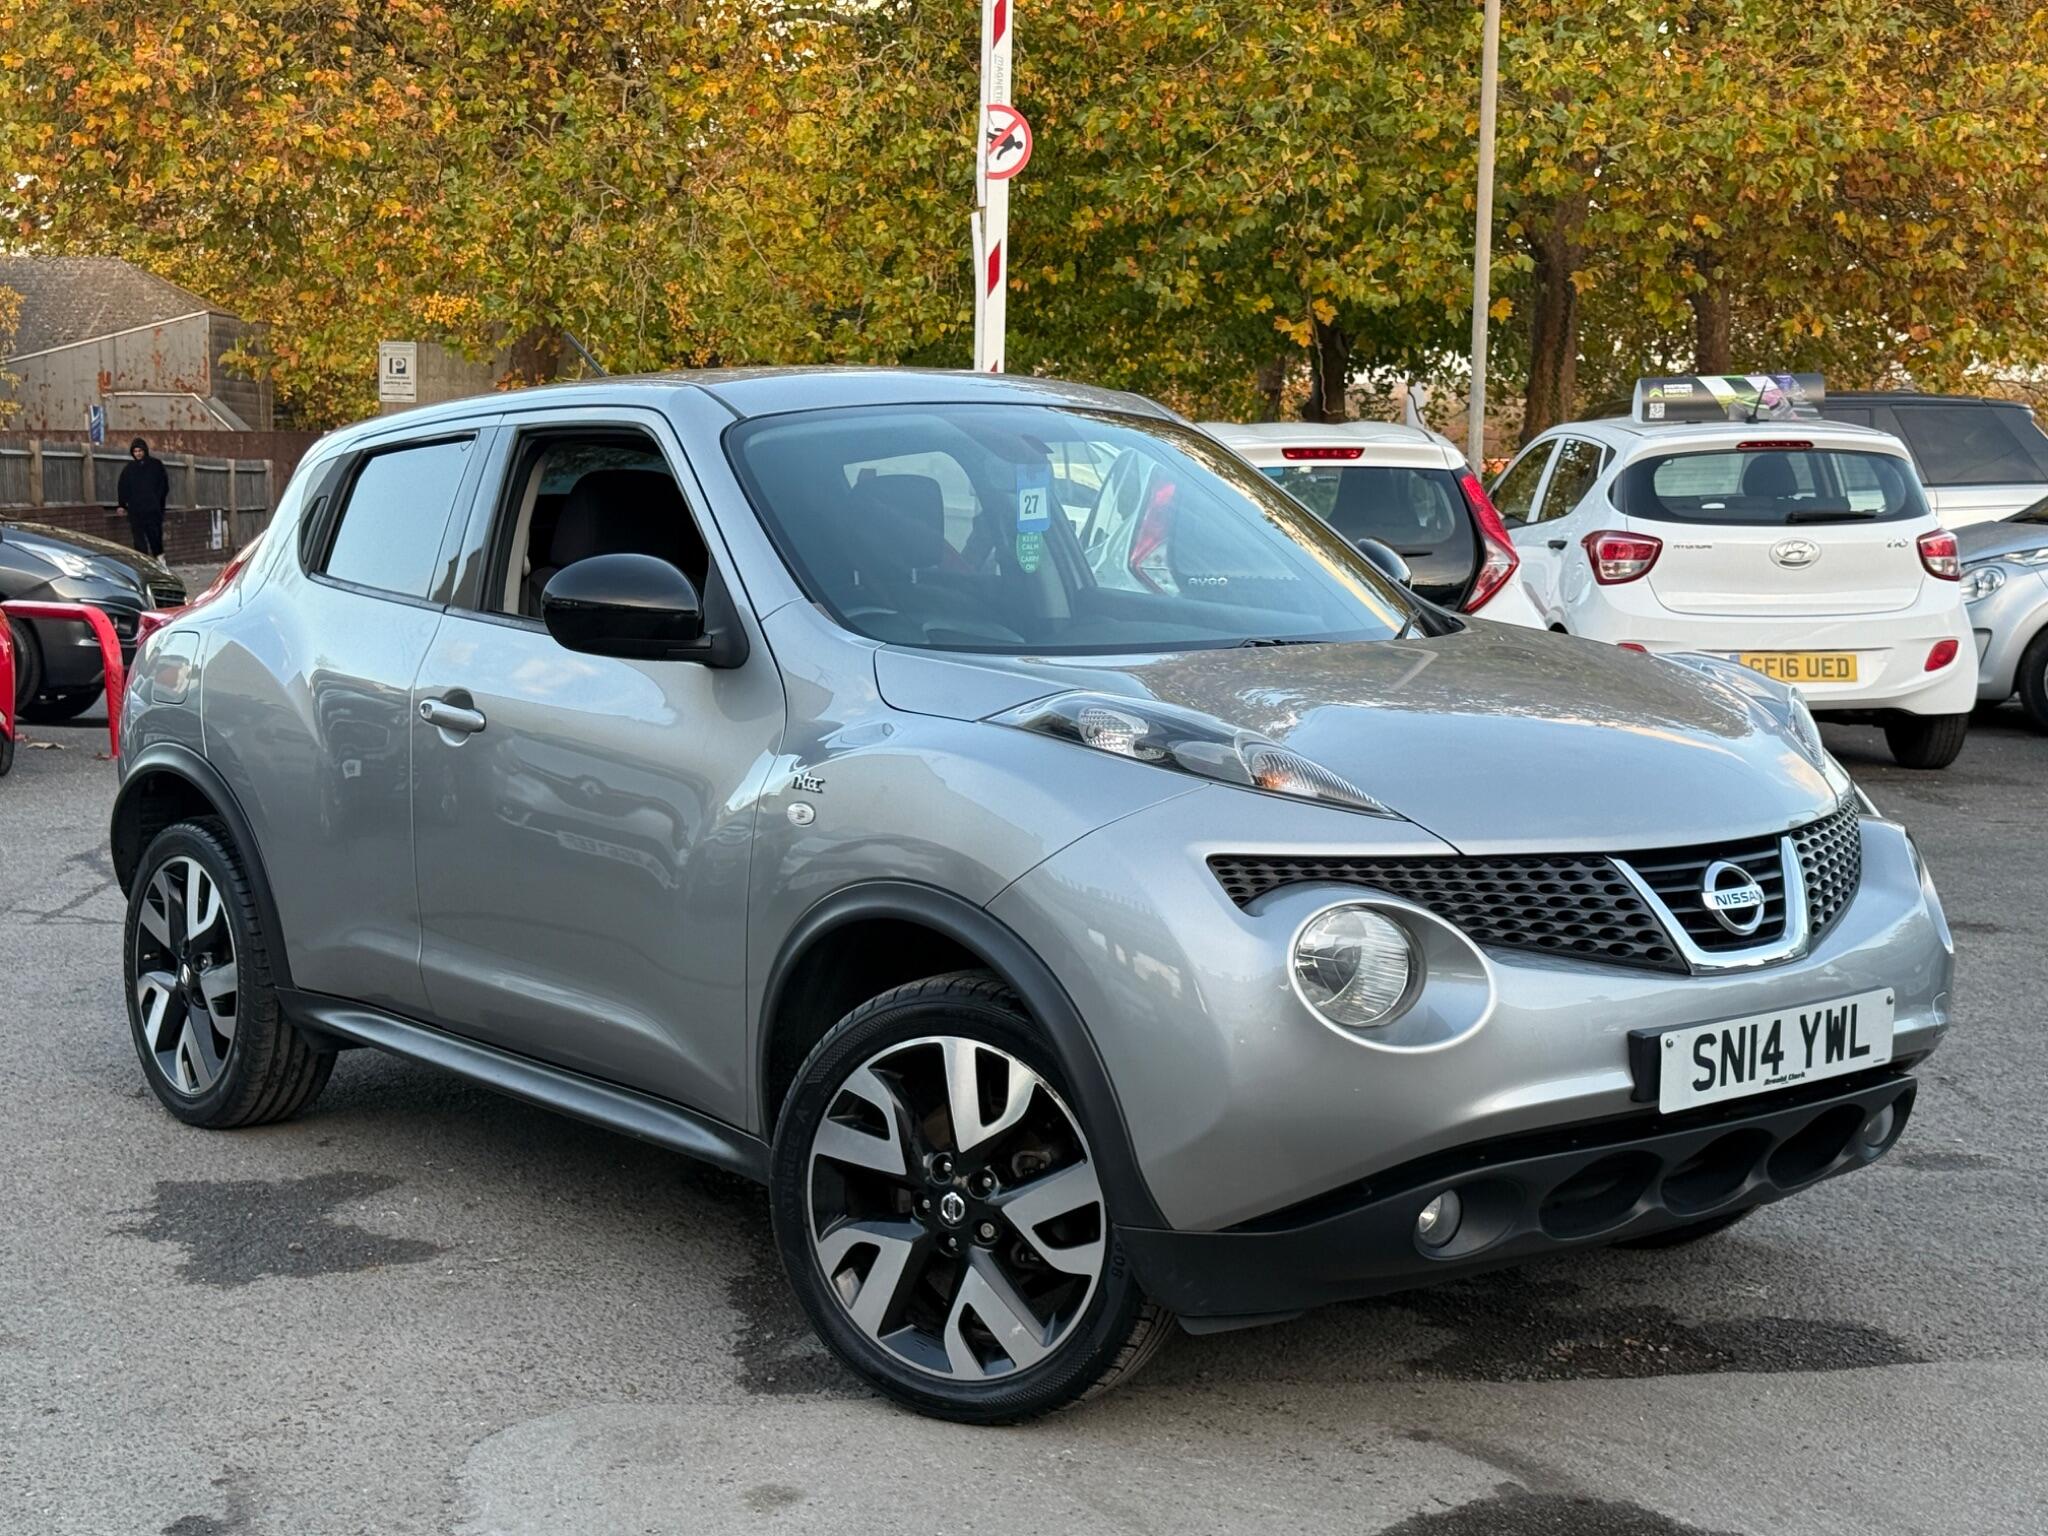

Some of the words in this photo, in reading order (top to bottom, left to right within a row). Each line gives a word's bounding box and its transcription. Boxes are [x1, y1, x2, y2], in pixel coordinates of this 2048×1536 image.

[1024, 494, 1040, 514] 27
[1806, 657, 1850, 678] UED
[1714, 889, 1764, 906] NISSAN
[1692, 1019, 1784, 1092] SN14
[1800, 1003, 1871, 1069] YWL
